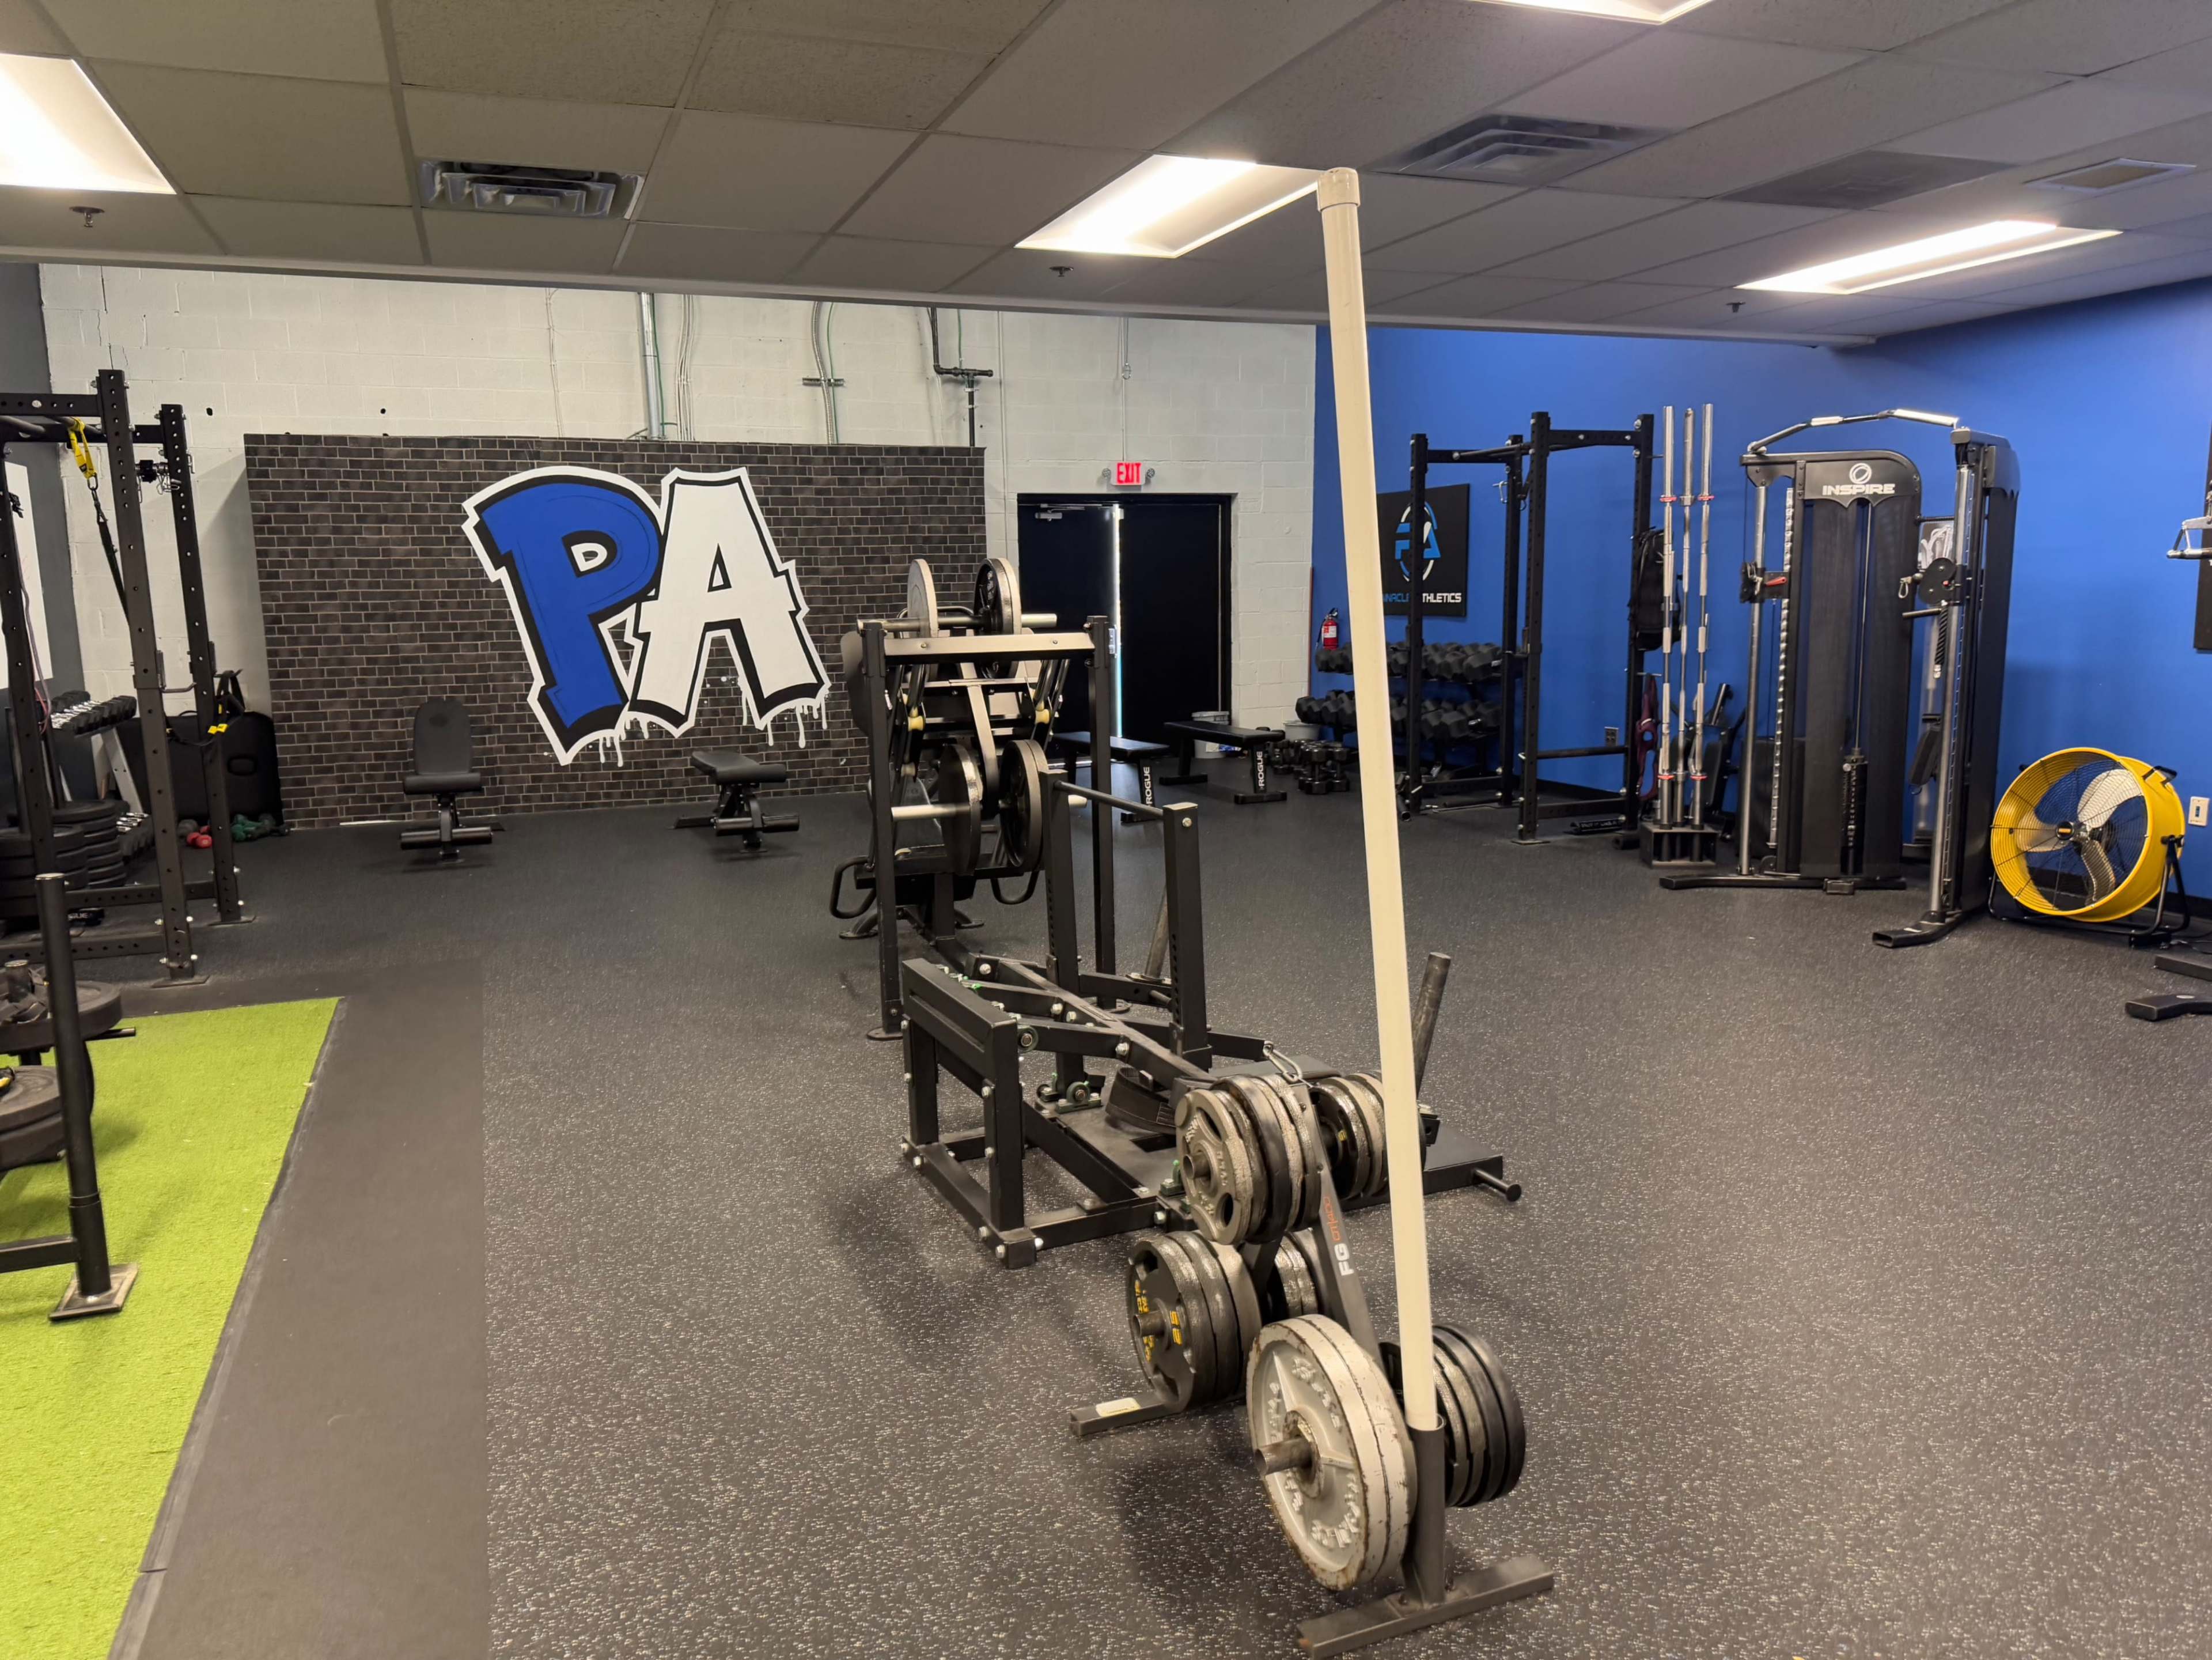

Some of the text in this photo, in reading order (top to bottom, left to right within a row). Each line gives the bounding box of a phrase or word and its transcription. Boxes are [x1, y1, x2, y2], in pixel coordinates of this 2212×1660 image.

[1116, 462, 1142, 484] EXIT
[1822, 483, 1896, 496] INSPIRE
[1422, 592, 1462, 603] THLETICS
[462, 465, 832, 766] PA
[1257, 751, 1267, 786] ROGUE
[1143, 766, 1153, 805] ROGUE
[1334, 1243, 1354, 1276] FG
